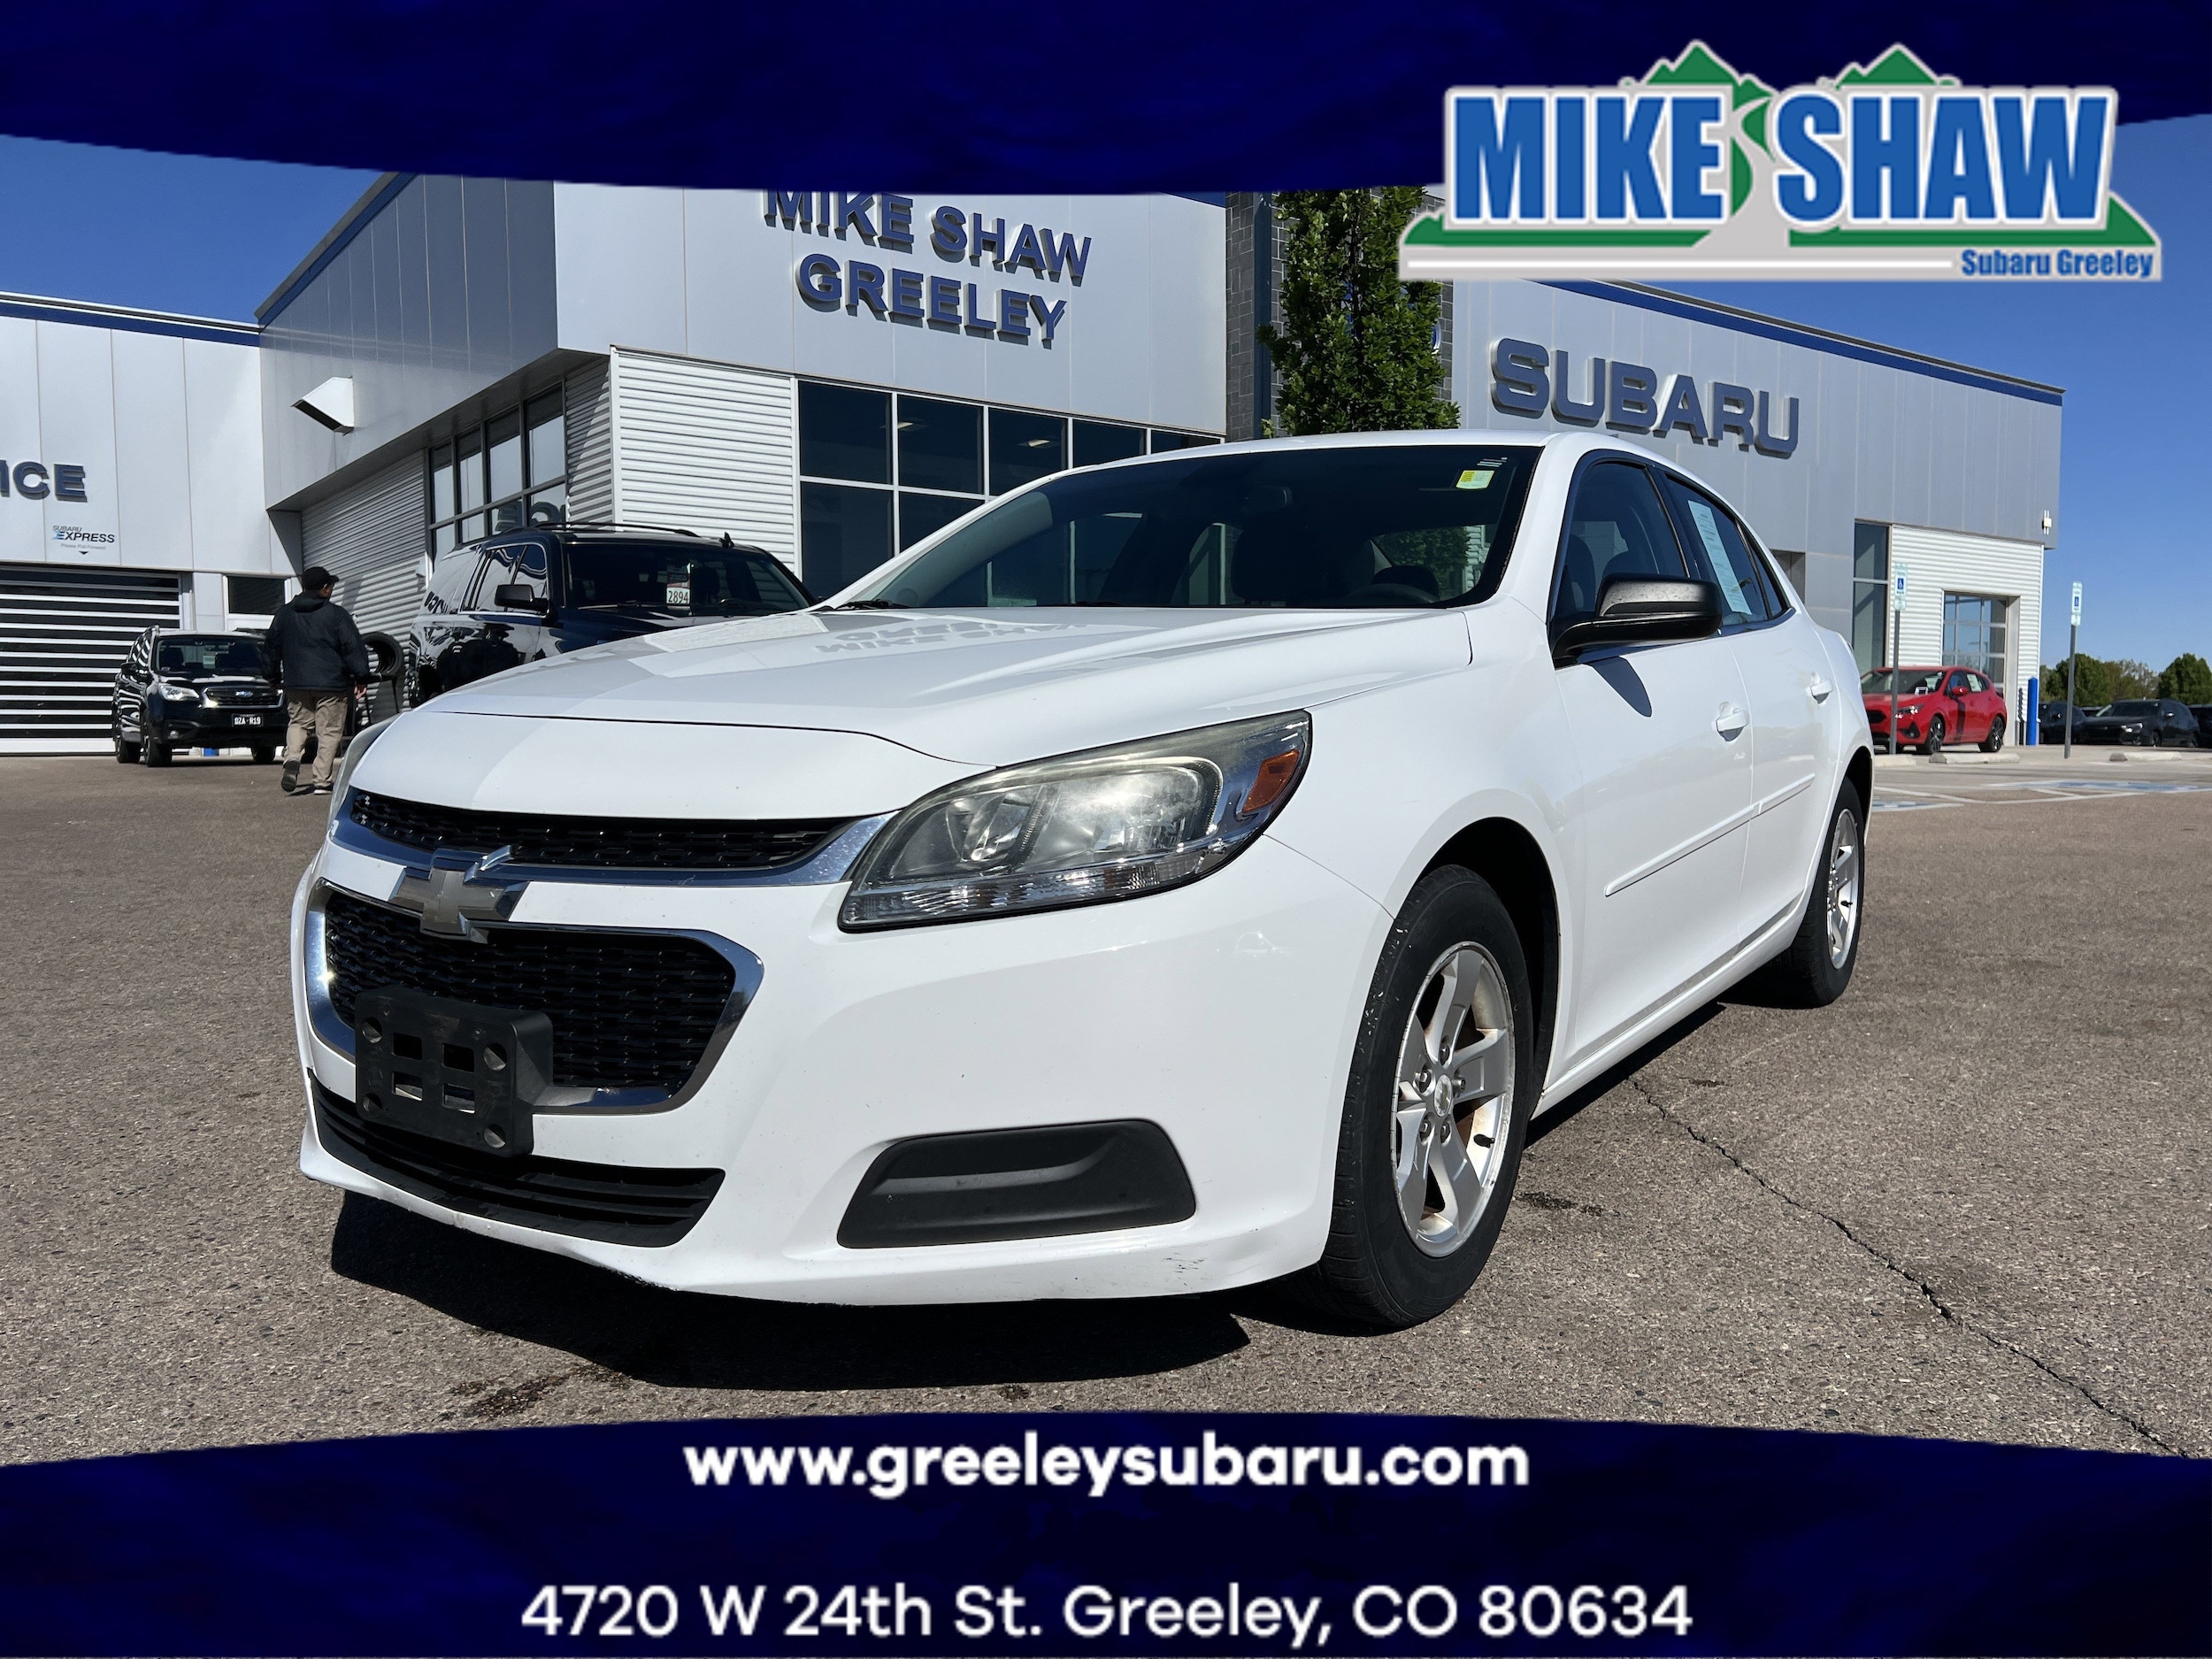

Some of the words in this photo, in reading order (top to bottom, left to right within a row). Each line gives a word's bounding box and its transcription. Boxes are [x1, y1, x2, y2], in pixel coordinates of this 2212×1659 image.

[763, 188, 915, 254] MIKE
[930, 206, 1092, 287] SHAW
[795, 253, 1067, 350] GREELEY
[1490, 338, 1800, 459] SUBARU
[53, 531, 116, 543] EXPRESS
[668, 590, 688, 603] 2894
